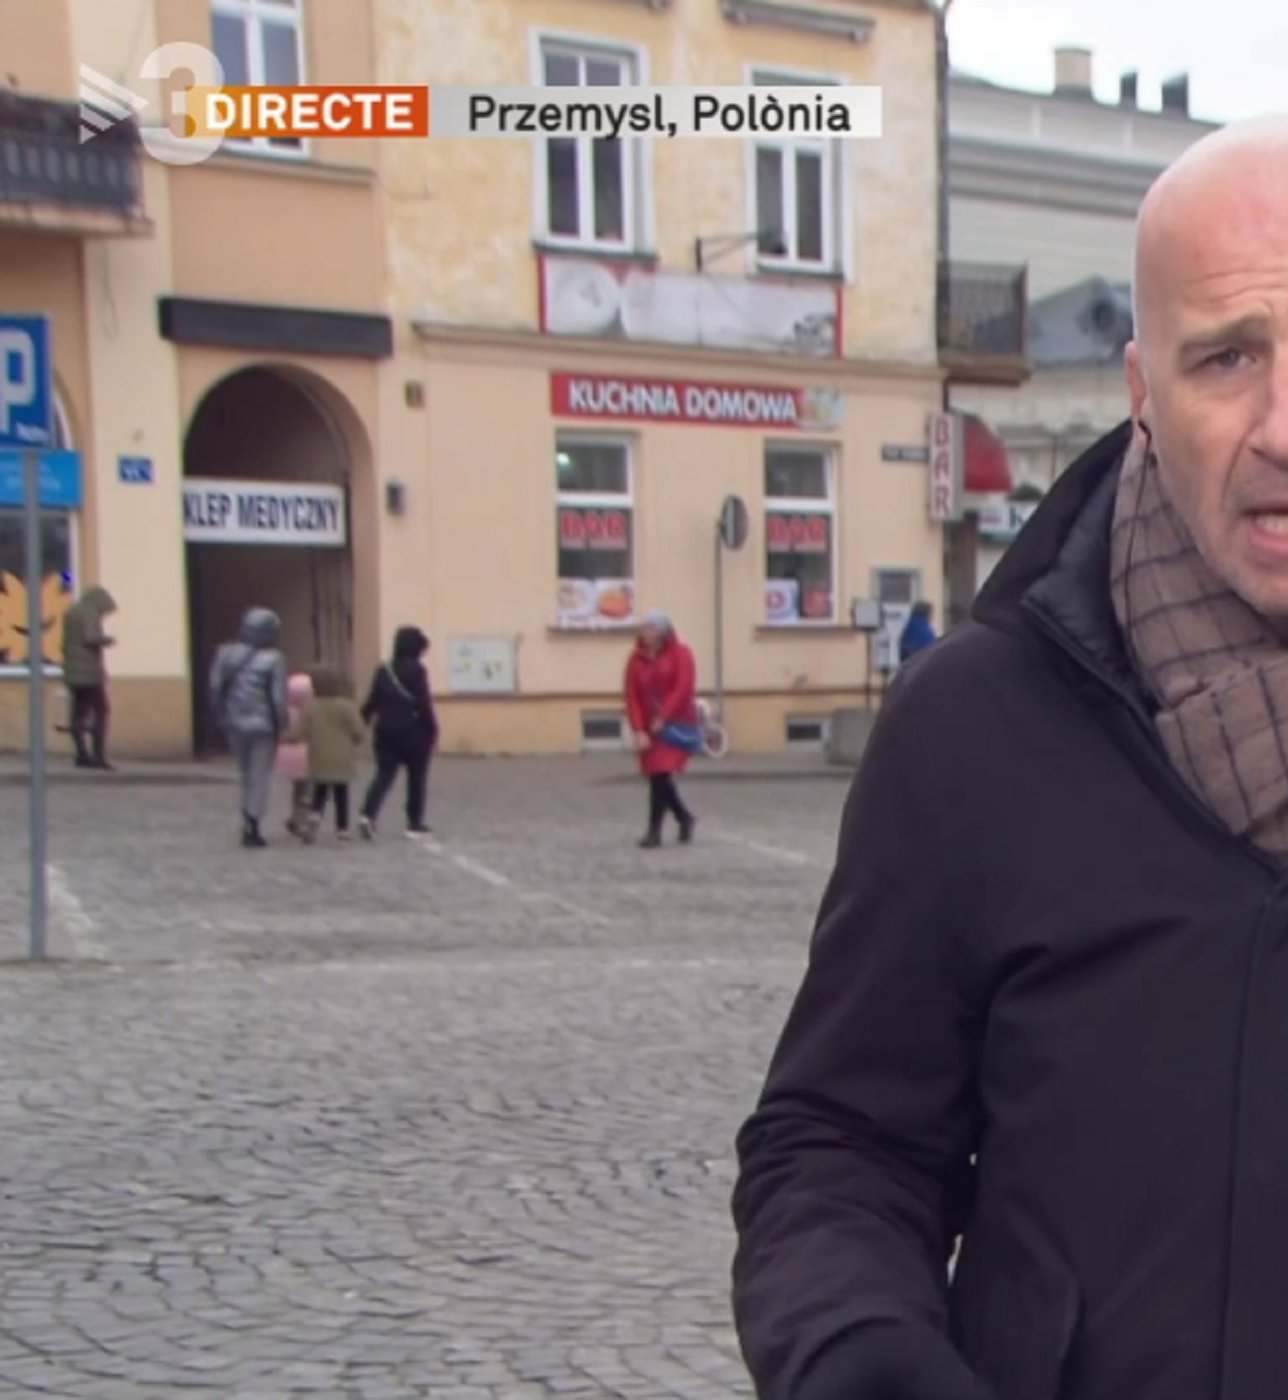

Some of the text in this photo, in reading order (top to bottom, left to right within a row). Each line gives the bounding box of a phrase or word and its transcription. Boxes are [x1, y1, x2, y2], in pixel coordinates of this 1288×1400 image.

[0, 327, 37, 435] P
[569, 380, 798, 422] KUCHNIA DOMOWA
[933, 417, 951, 516] BAR
[237, 494, 339, 532] MEDYCZNY
[561, 511, 627, 540] BAR
[768, 516, 827, 544] BAR
